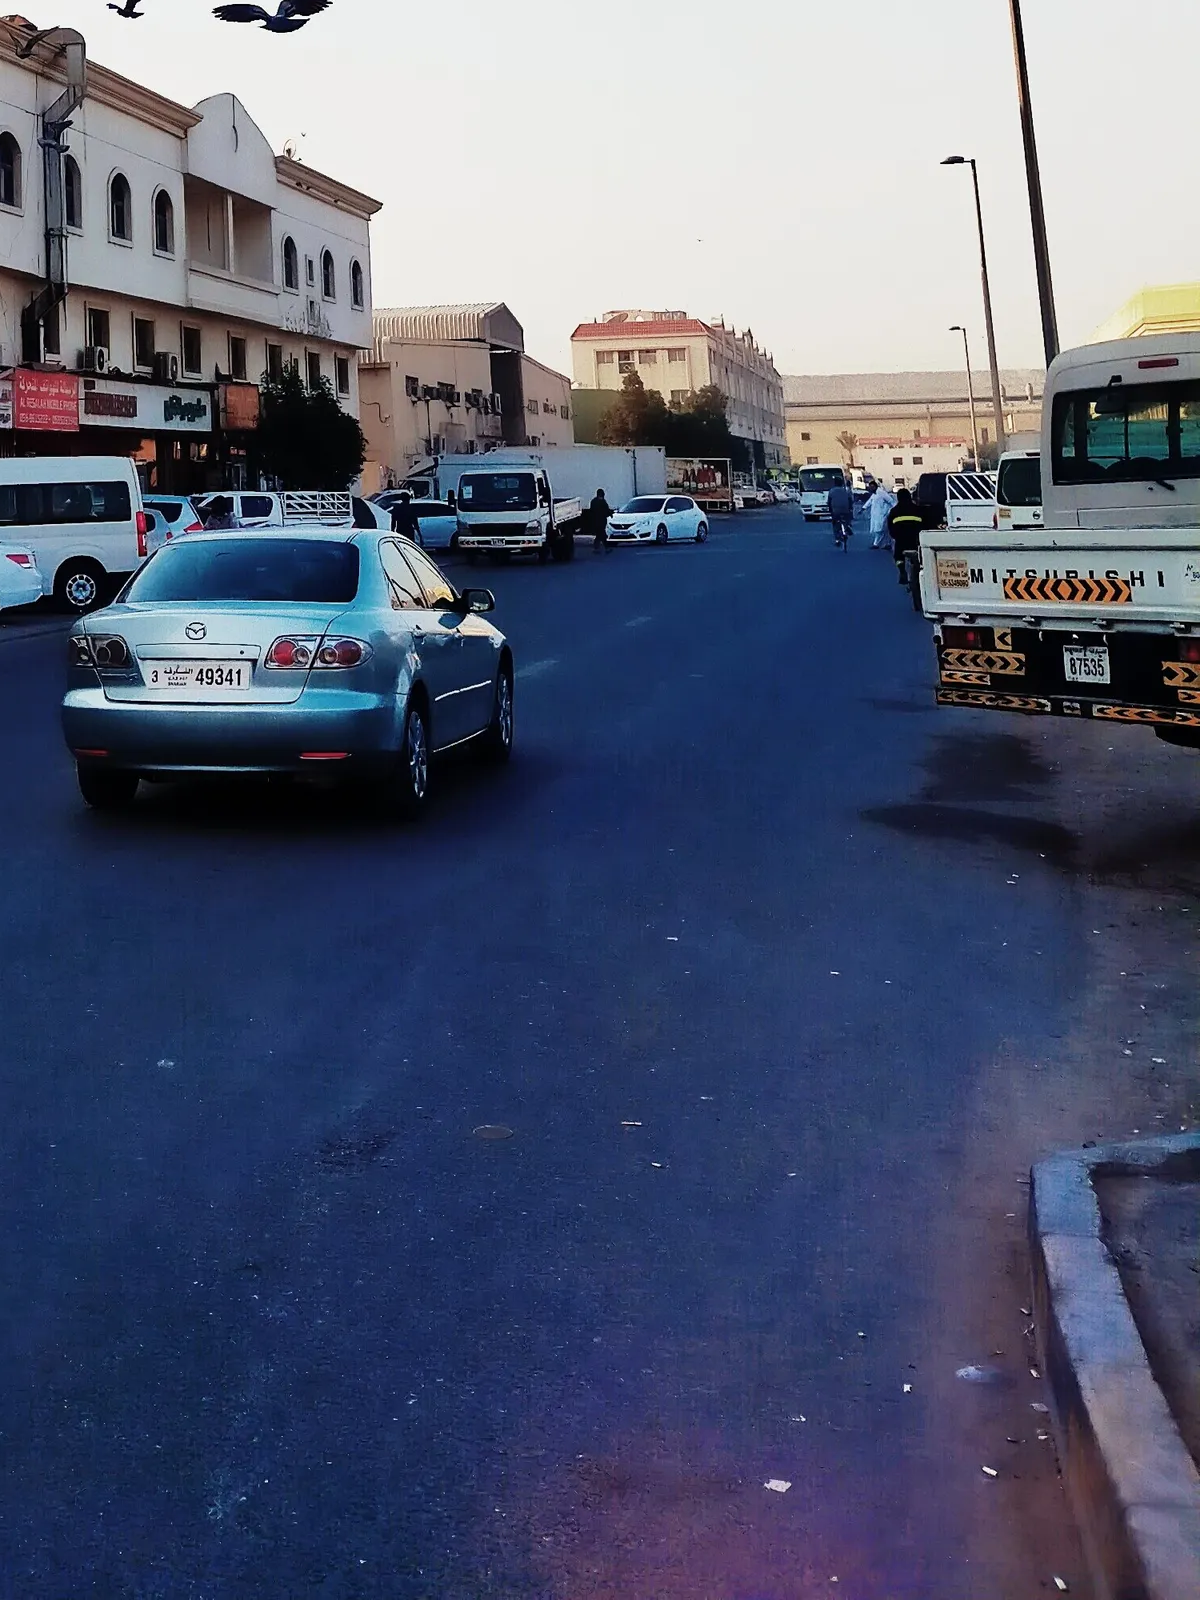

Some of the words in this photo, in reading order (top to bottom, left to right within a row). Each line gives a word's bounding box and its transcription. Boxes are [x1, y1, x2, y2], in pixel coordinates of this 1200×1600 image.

[1070, 656, 1105, 677] 87535
[151, 670, 159, 683] 3
[195, 668, 242, 686] 49341
